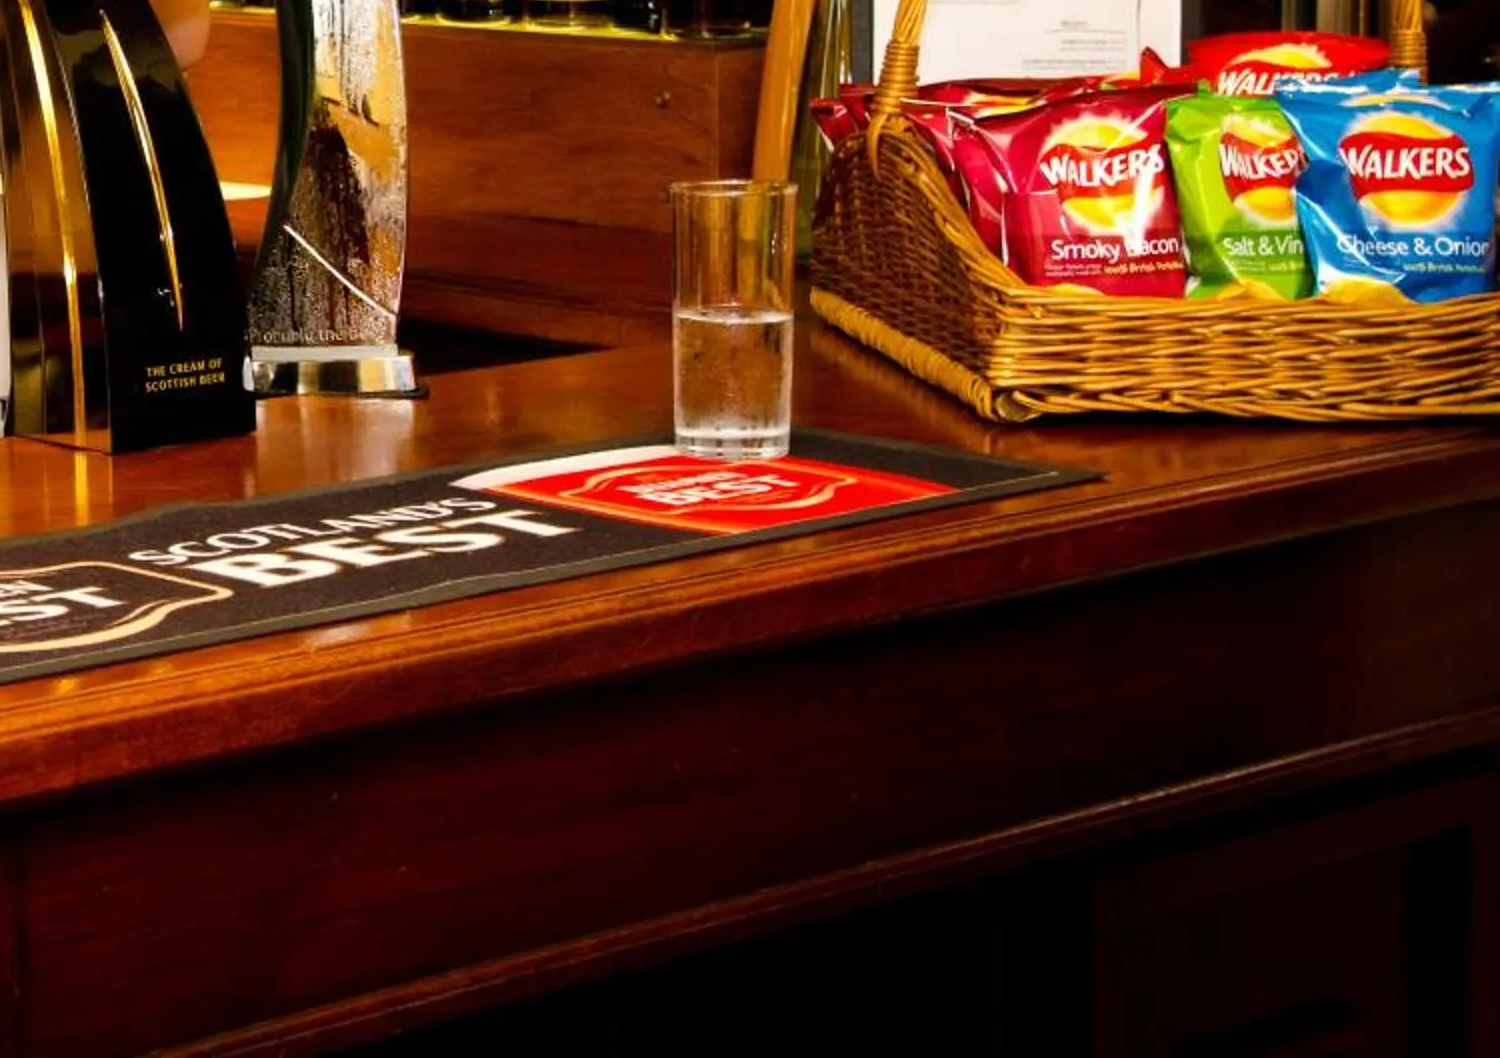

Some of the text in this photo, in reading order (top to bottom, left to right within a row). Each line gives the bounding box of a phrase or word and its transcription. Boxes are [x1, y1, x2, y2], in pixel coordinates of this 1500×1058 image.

[1039, 143, 1165, 187] WALKERS
[1338, 144, 1471, 181] WALKERS
[1051, 239, 1121, 264] Smoky
[1223, 235, 1257, 256] Salt
[1258, 235, 1275, 256] &
[1336, 234, 1409, 256] Cheese
[1413, 237, 1434, 256] &
[146, 357, 222, 378] THE CREAM OF
[145, 371, 225, 392] SCOTTISH BEER
[128, 496, 498, 566] SCOTLAND'S
[185, 509, 583, 587] BEST
